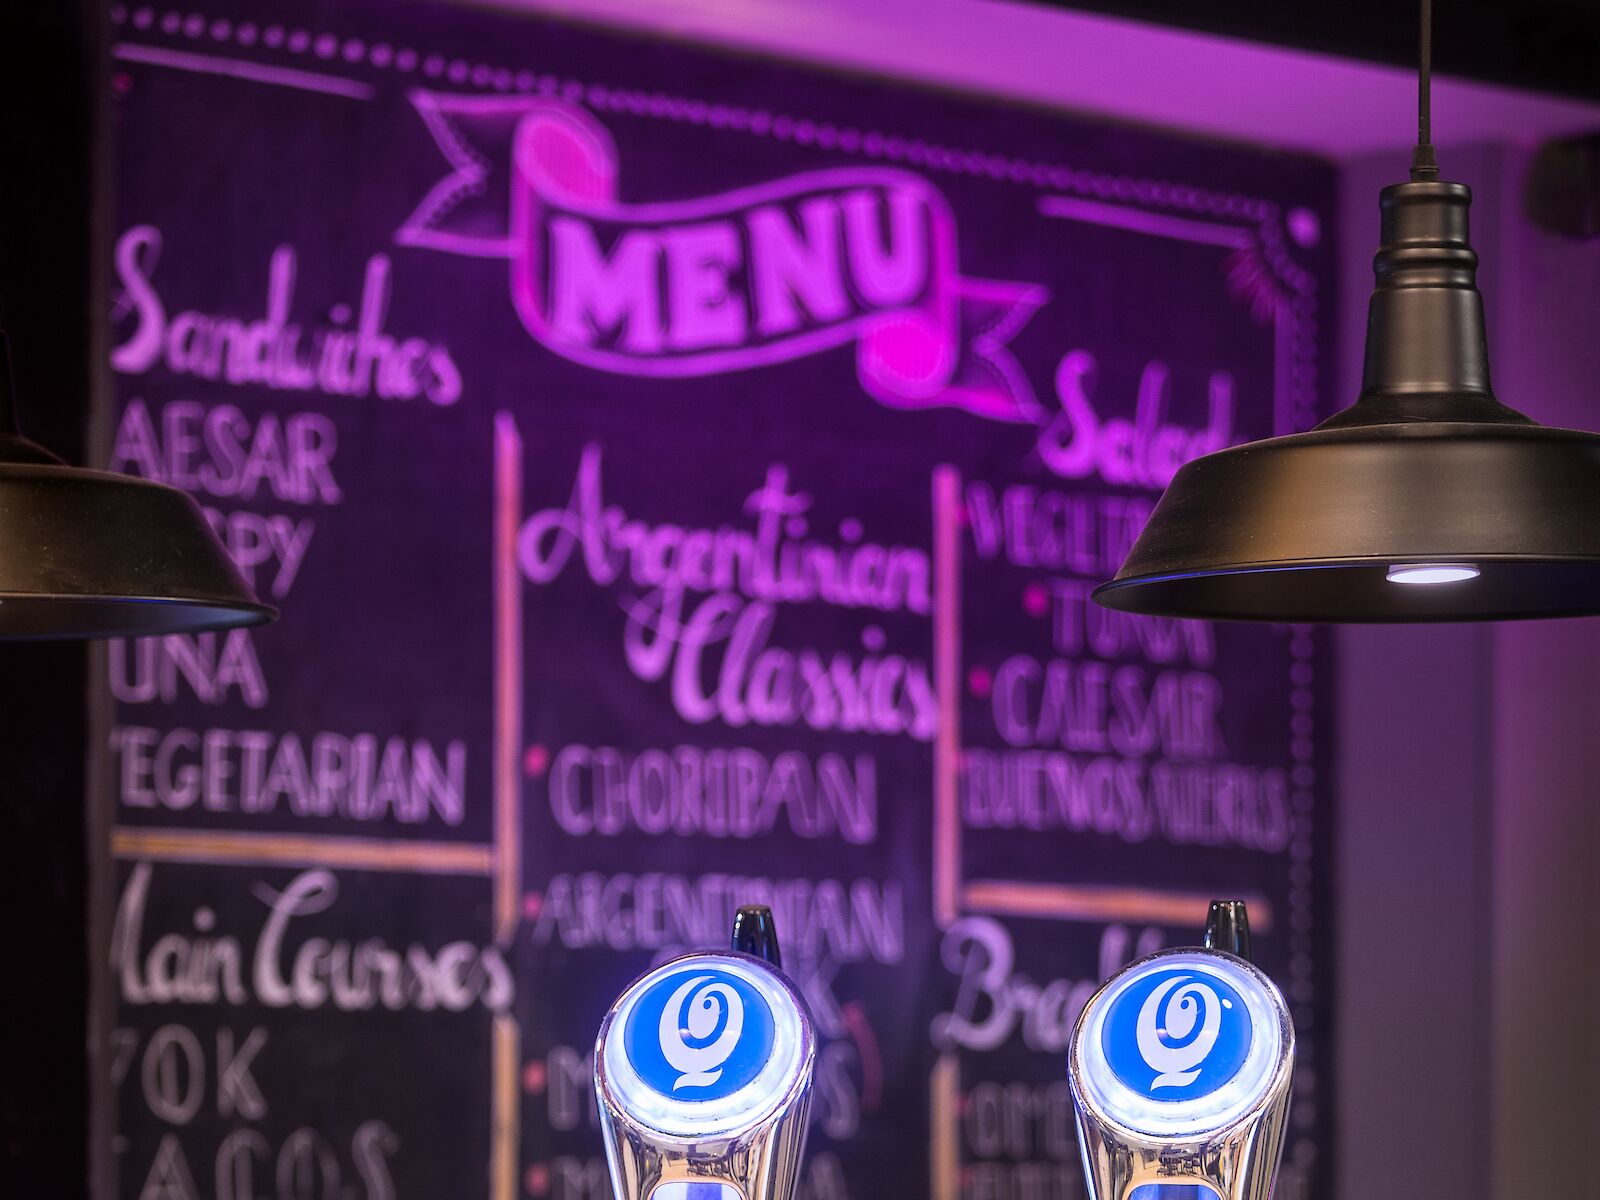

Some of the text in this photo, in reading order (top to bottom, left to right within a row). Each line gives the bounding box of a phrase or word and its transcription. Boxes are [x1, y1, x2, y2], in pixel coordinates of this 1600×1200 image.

[548, 186, 929, 353] MENU
[517, 440, 930, 682] Argentinian
[622, 590, 942, 743] Classics
[992, 653, 1226, 759] CAESAR
[110, 728, 467, 826] EGETARIAN
[549, 743, 877, 845] CHORIPAN
[248, 868, 516, 1012] Courses
[659, 976, 745, 1092] Q
[1136, 976, 1222, 1092] Q
